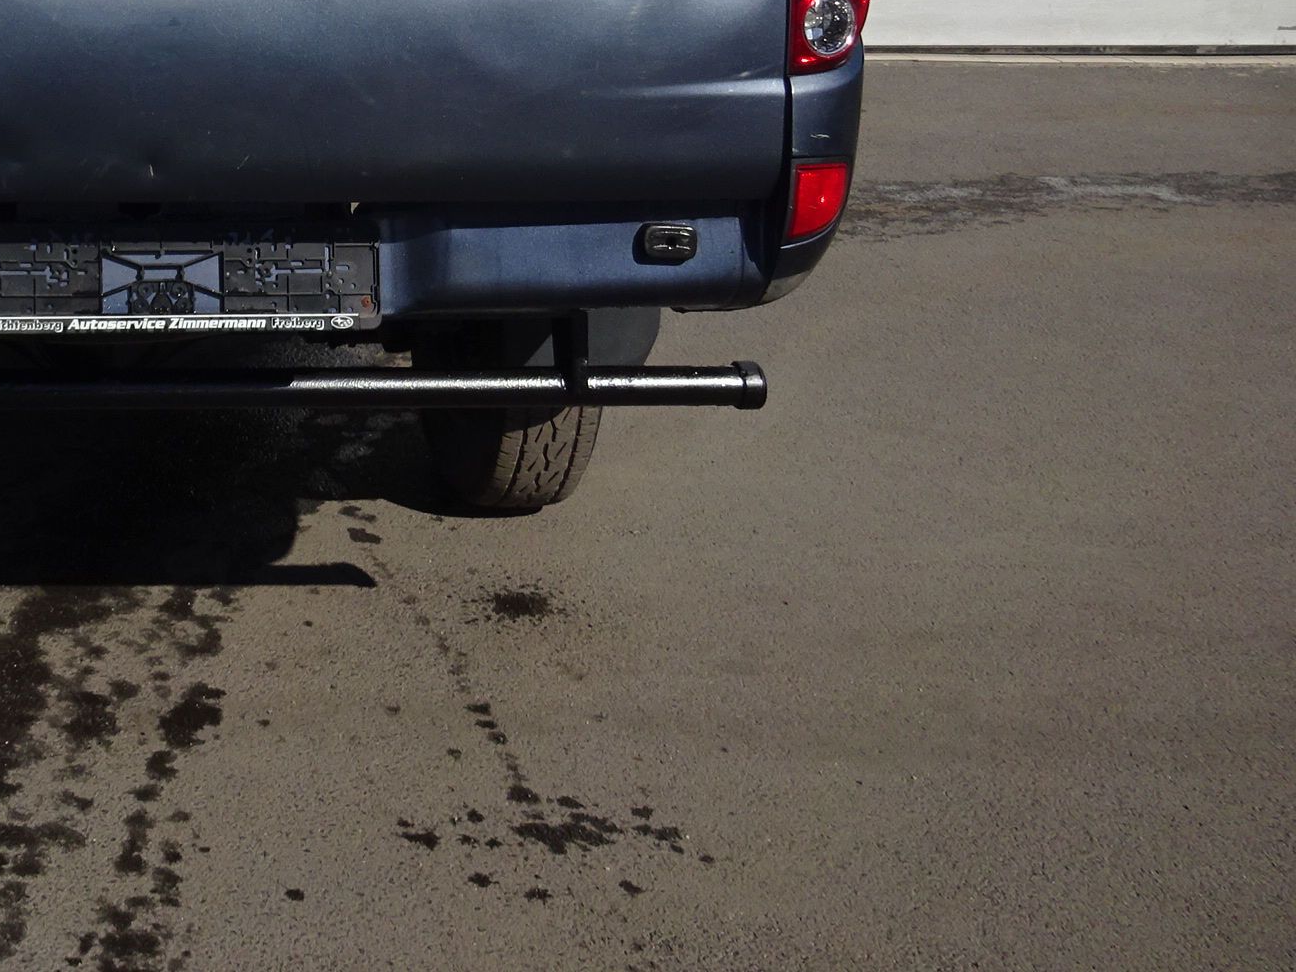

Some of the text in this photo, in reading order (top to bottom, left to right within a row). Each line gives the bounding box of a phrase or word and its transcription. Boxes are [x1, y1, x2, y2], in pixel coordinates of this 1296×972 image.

[67, 318, 166, 330] Autoservice
[168, 317, 267, 329] Zimmermann
[271, 316, 325, 331] Freiberg
